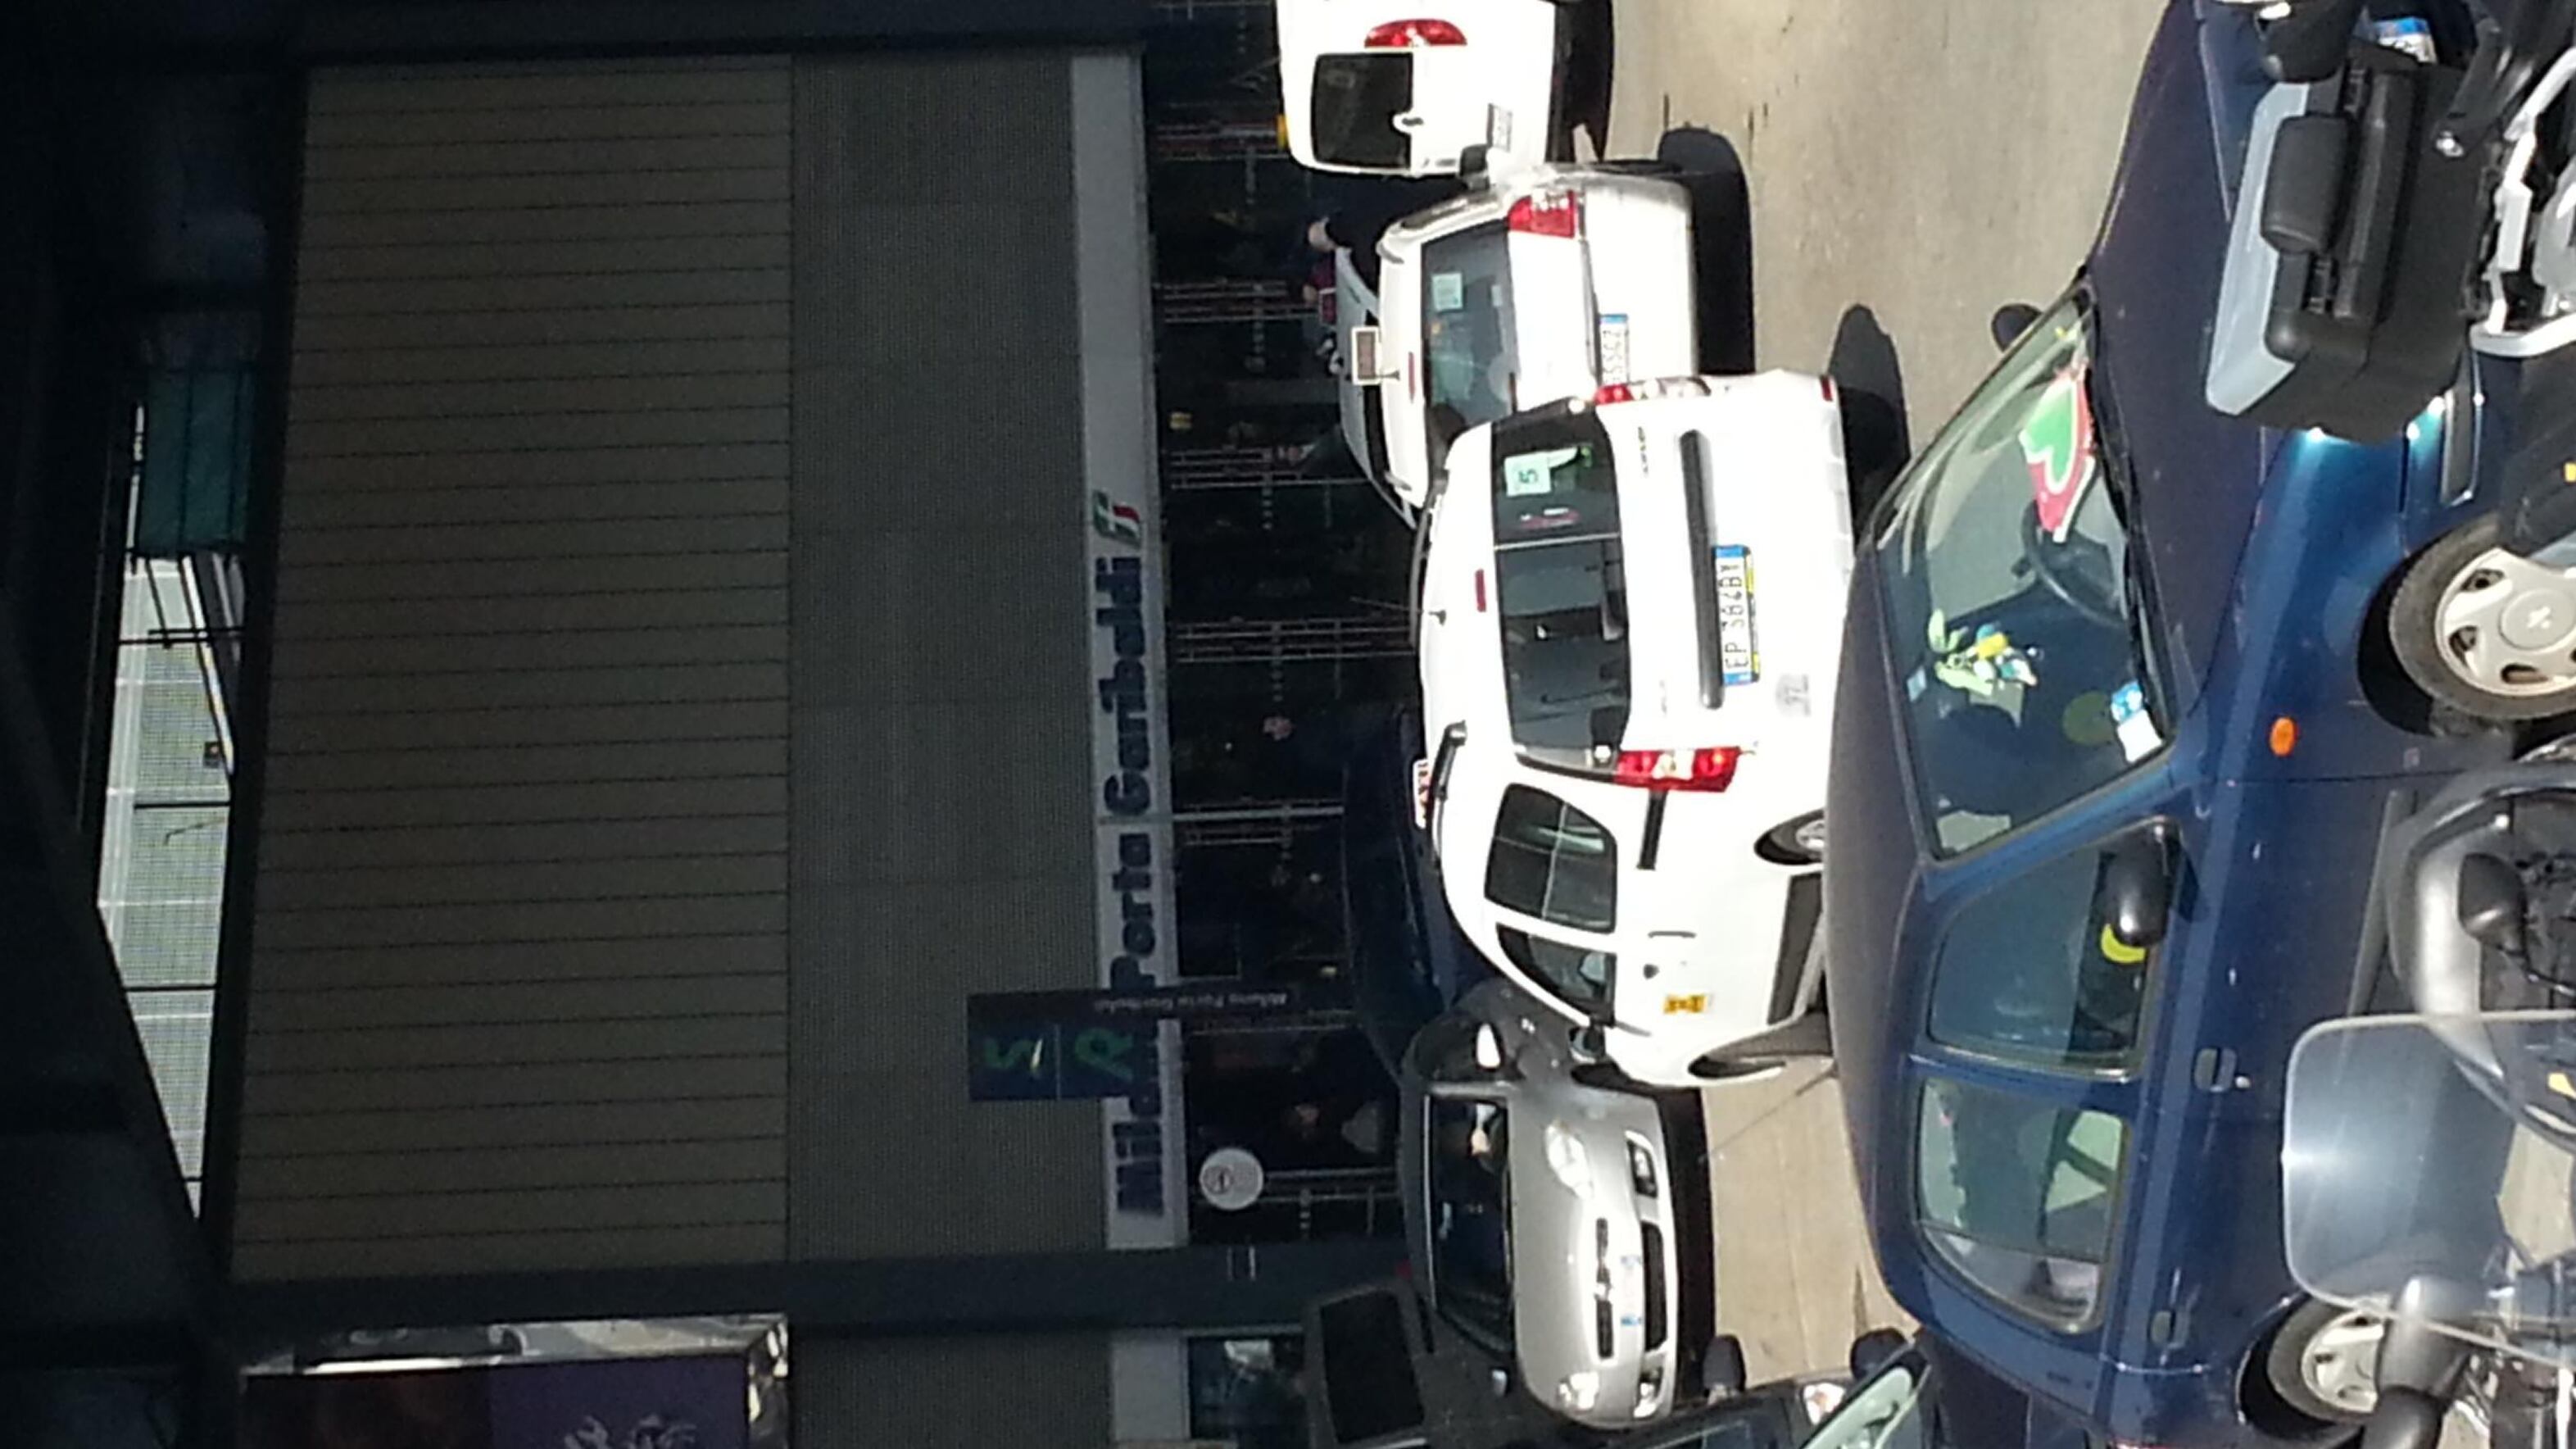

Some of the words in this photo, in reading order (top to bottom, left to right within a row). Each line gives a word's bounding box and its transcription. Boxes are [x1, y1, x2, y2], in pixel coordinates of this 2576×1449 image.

[1095, 556, 1150, 818] Garibaldi
[1108, 834, 1155, 993] Porta
[1112, 1016, 1163, 1213] Mila
